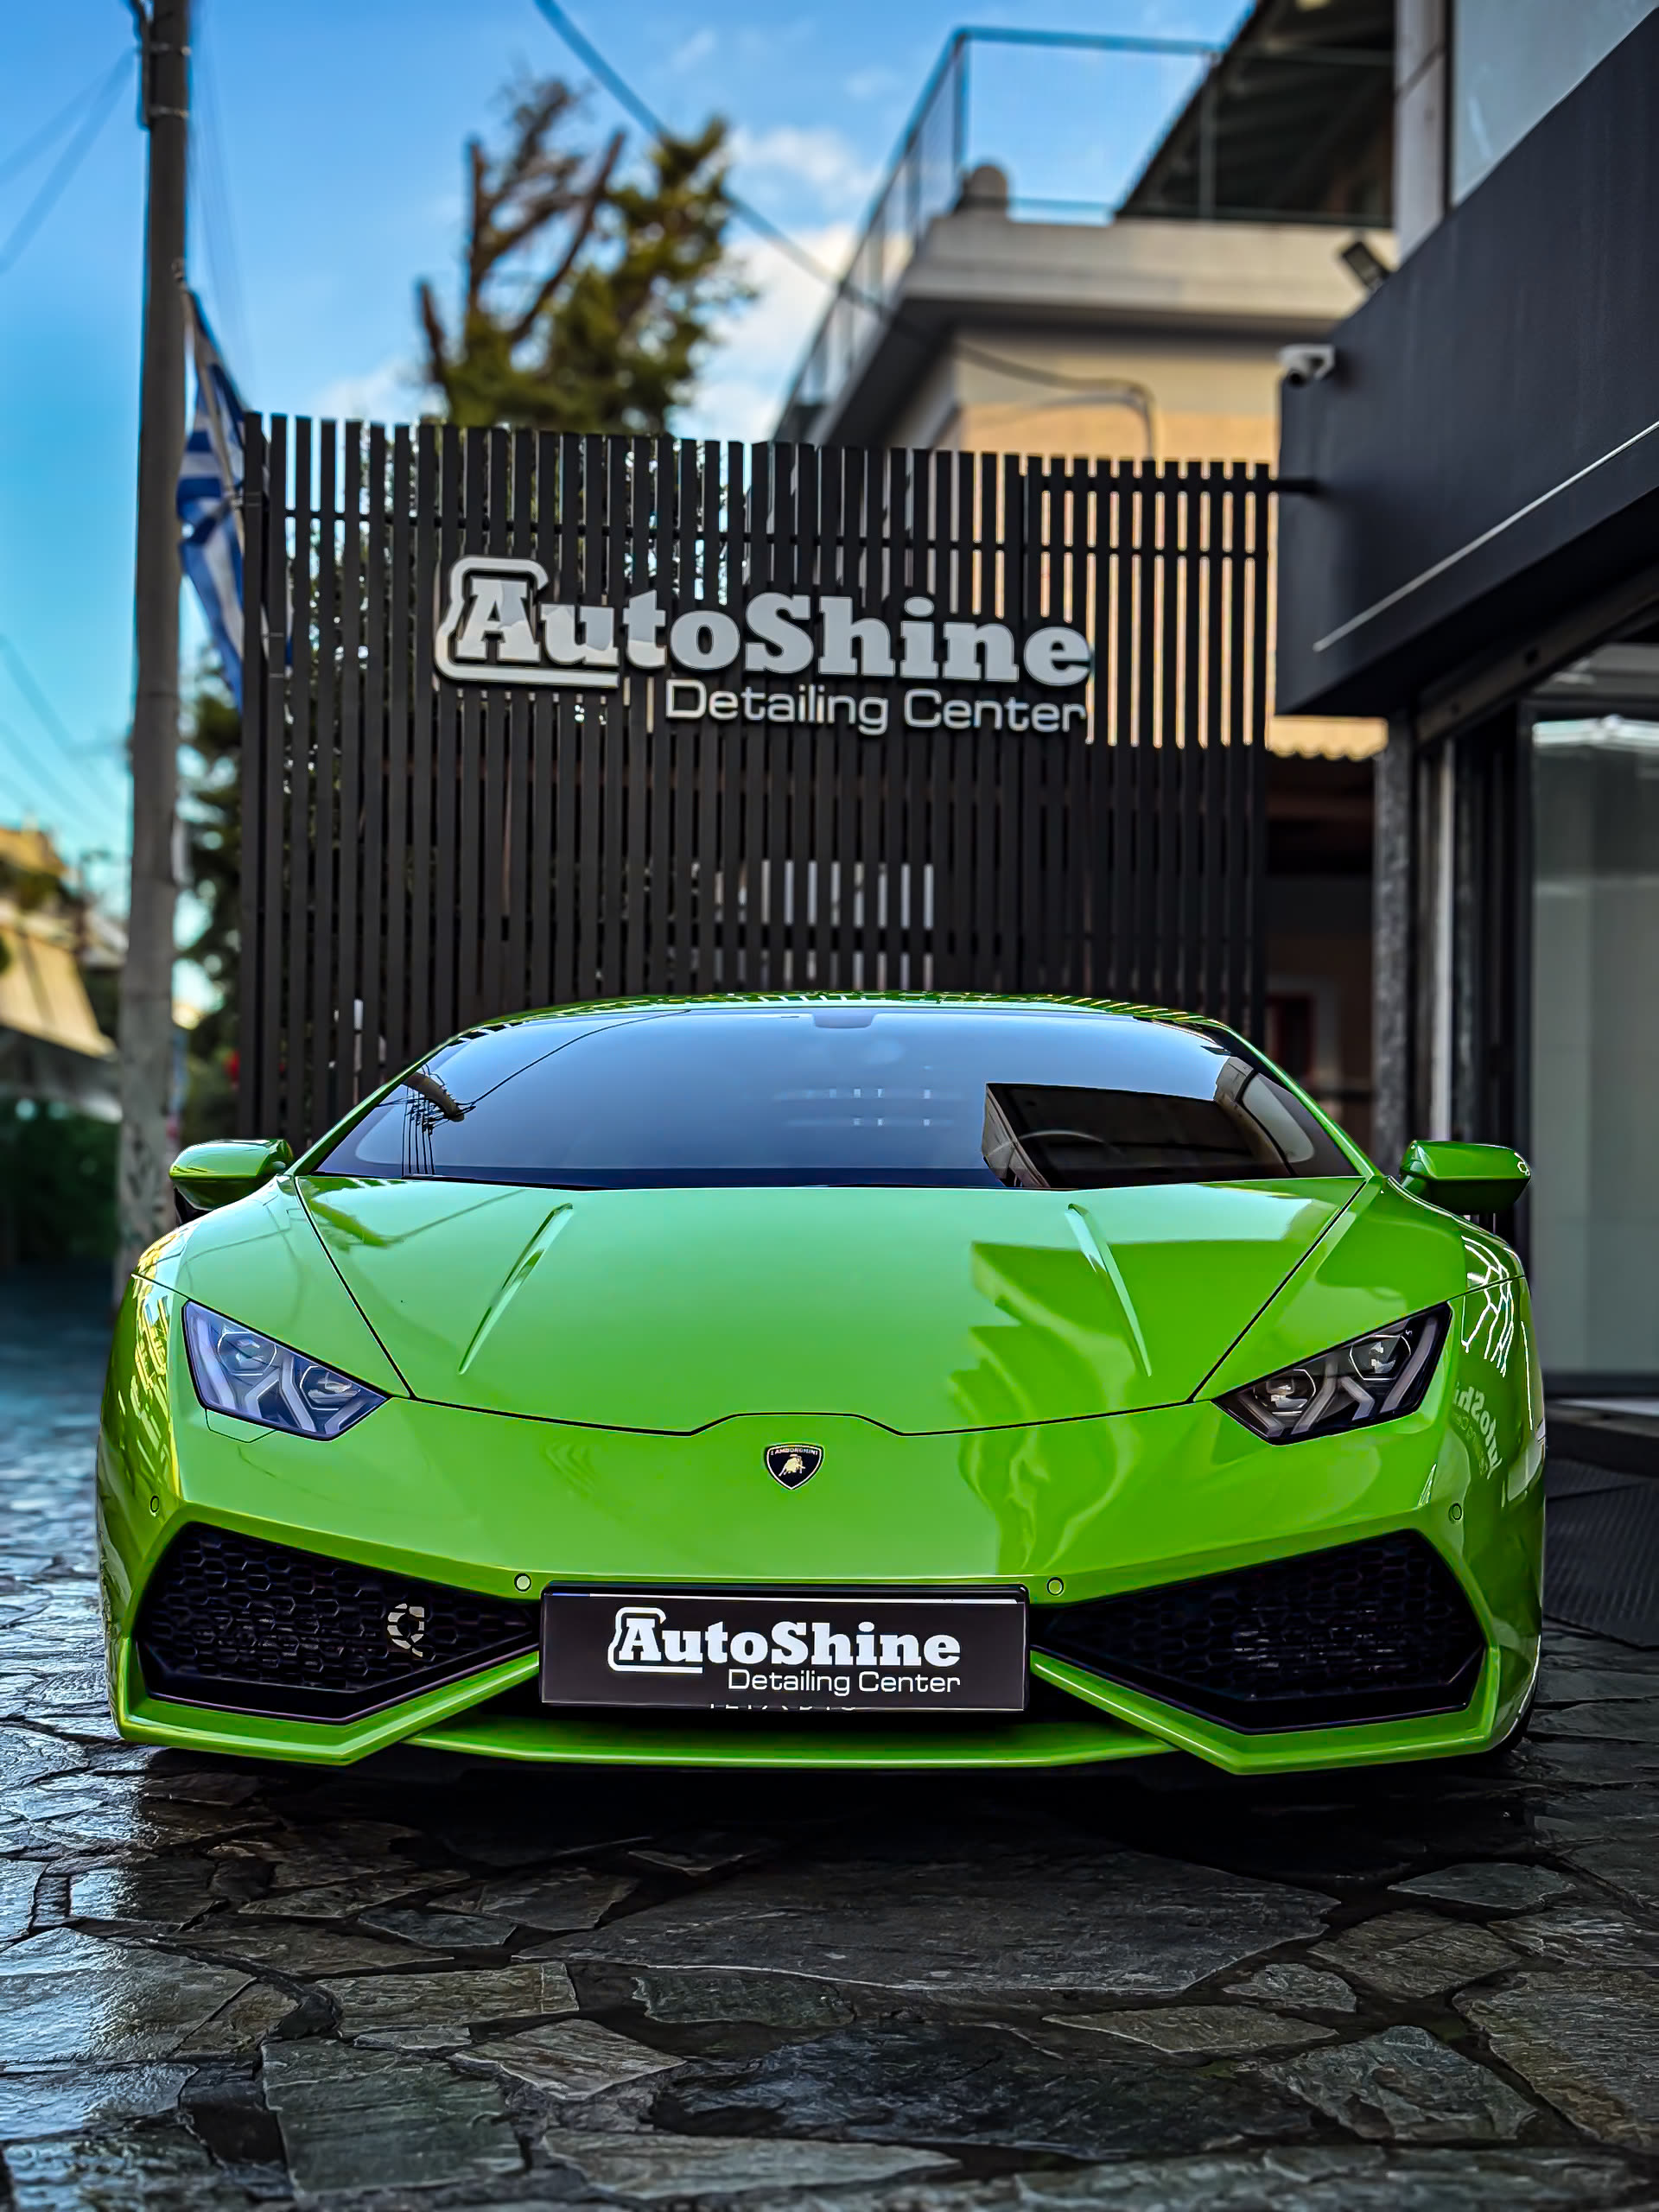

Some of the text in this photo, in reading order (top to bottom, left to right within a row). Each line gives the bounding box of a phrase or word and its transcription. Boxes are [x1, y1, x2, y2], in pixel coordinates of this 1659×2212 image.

[454, 575, 1091, 687] AutoShine
[664, 678, 1087, 736] Detailing Center
[618, 1617, 962, 1668] AutoShine
[728, 1668, 961, 1697] Detailing Center
